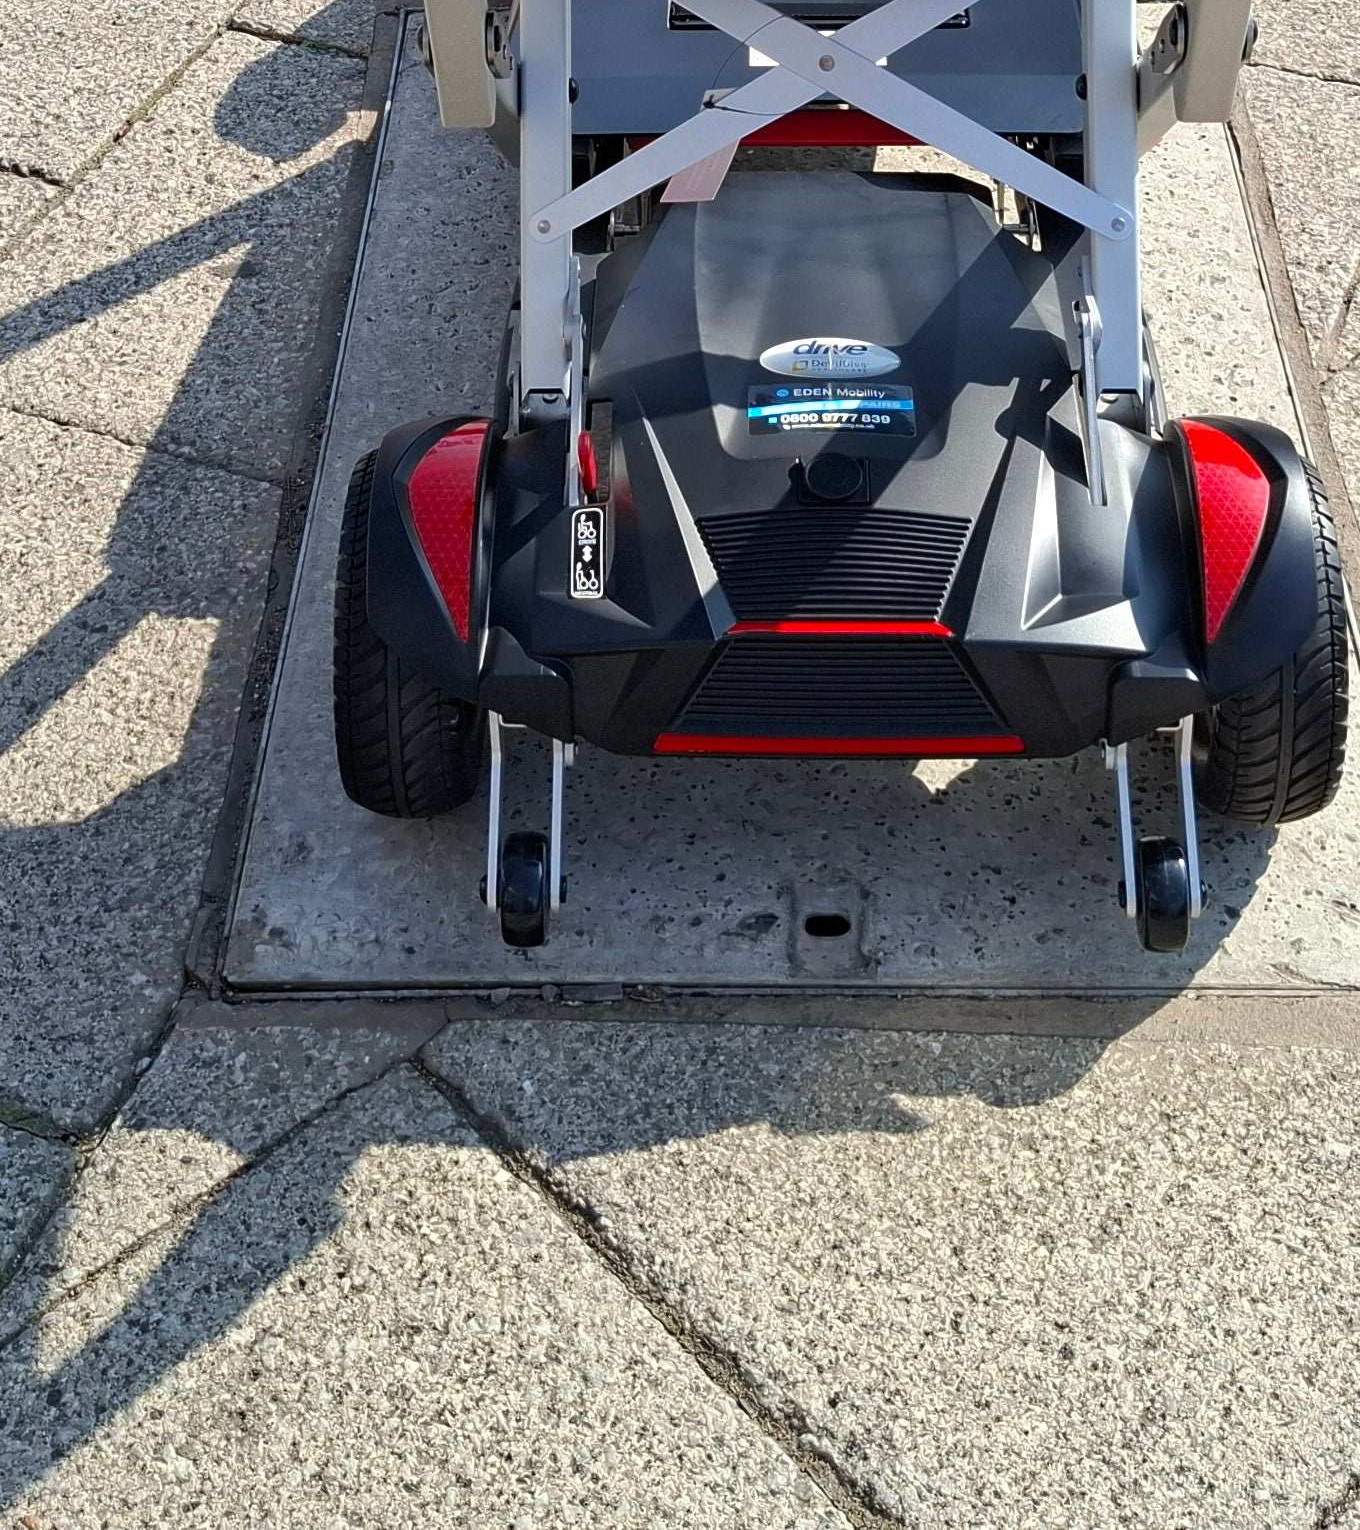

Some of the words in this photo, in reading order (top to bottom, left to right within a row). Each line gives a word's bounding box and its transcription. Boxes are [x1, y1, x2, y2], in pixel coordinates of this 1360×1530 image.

[792, 340, 868, 356] drive
[793, 387, 833, 397] EDEN
[836, 387, 886, 399] Mobility
[780, 413, 818, 424] 0800
[861, 414, 891, 424] 839
